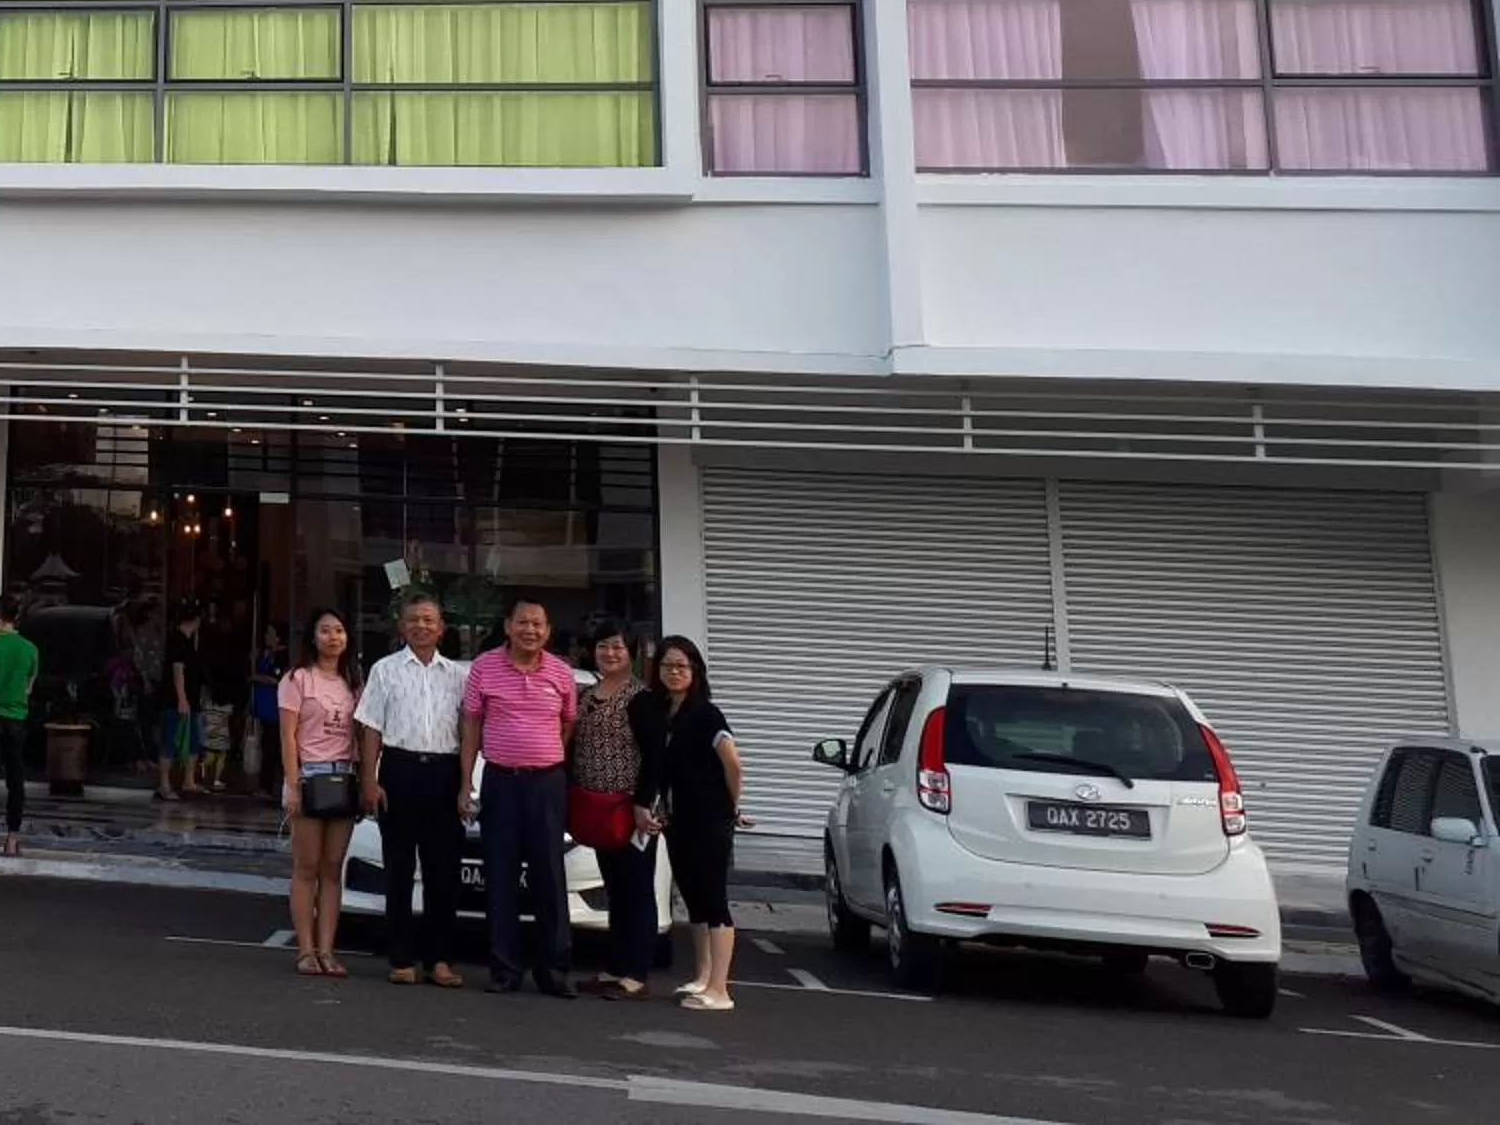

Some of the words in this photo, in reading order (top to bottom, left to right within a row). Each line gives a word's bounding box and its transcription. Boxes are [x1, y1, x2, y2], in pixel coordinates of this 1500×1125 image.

[1047, 807, 1079, 826] QAX
[1086, 811, 1131, 830] 2725
[461, 866, 485, 885] QA
